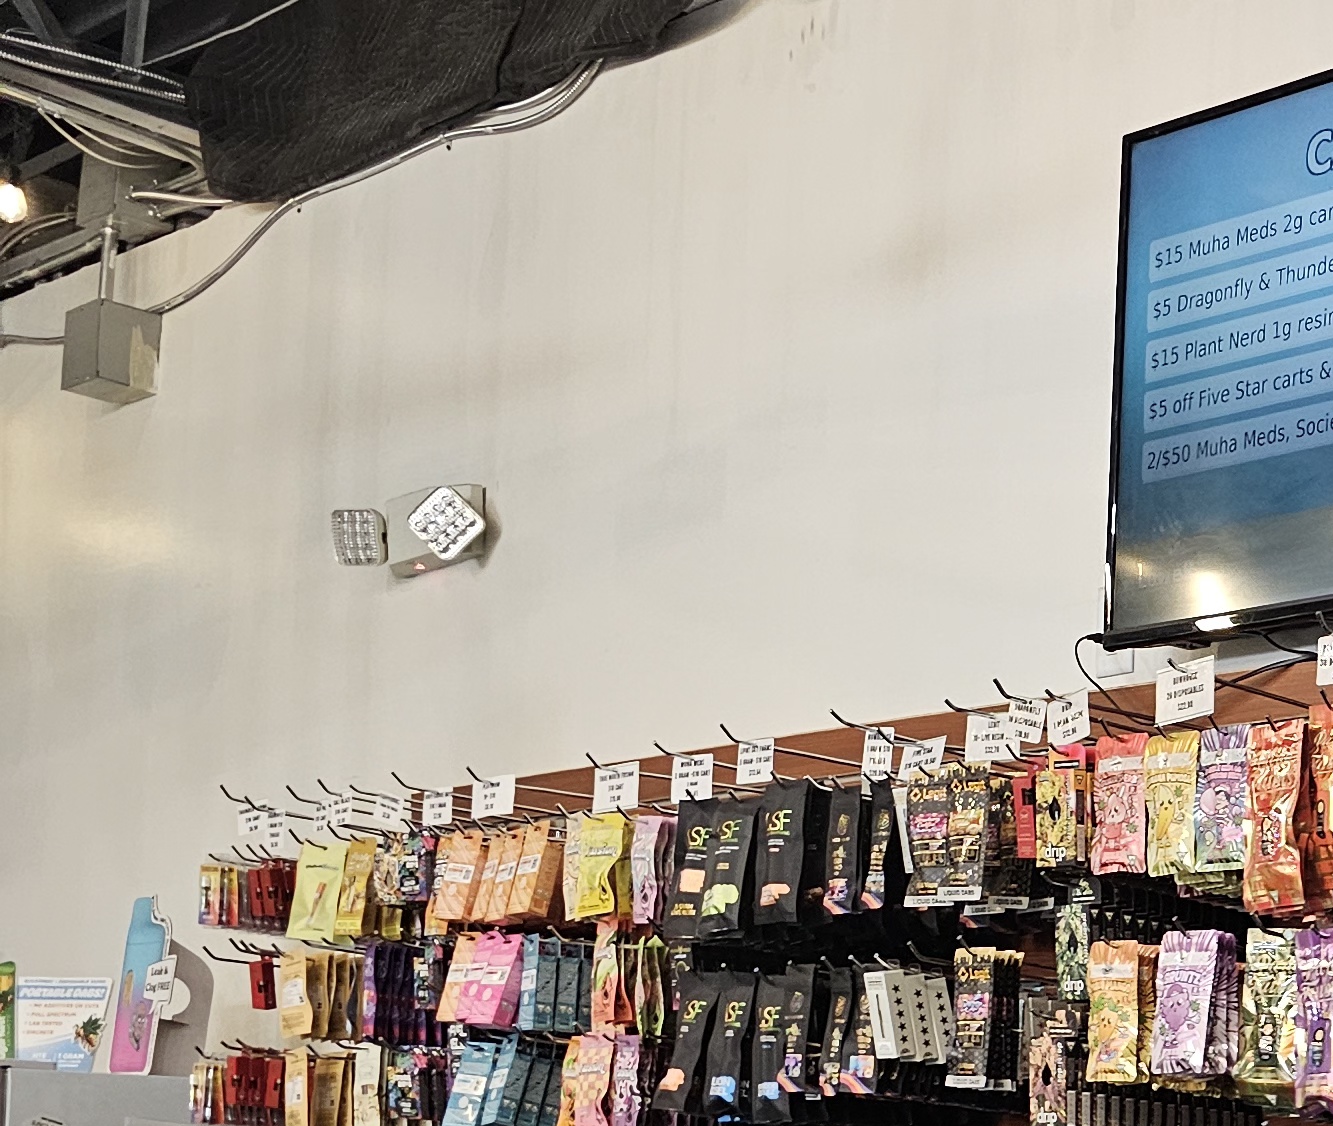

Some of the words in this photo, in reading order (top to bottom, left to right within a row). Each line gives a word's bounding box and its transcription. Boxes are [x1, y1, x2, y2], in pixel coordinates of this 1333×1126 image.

[1154, 240, 1183, 270] $15
[1188, 234, 1231, 260] Muha
[1236, 223, 1278, 250] Meds
[1282, 213, 1304, 235] 2g
[1152, 297, 1172, 320] $5
[1177, 275, 1253, 316] Dragonfly
[1258, 271, 1271, 292] &
[1150, 345, 1180, 371] $15
[1184, 334, 1224, 361] Plant
[1228, 322, 1267, 349] Nerd
[1271, 320, 1292, 342] 1g
[1148, 400, 1168, 421] $5
[1172, 391, 1195, 414] off
[1197, 386, 1230, 411] Five
[1235, 378, 1267, 400] Star
[1272, 366, 1314, 393] carts
[1318, 361, 1332, 381] &
[1146, 445, 1192, 472] 2/$50
[1194, 434, 1238, 460] Muha
[1243, 423, 1291, 450] Meds,
[1044, 843, 1067, 862] drip
